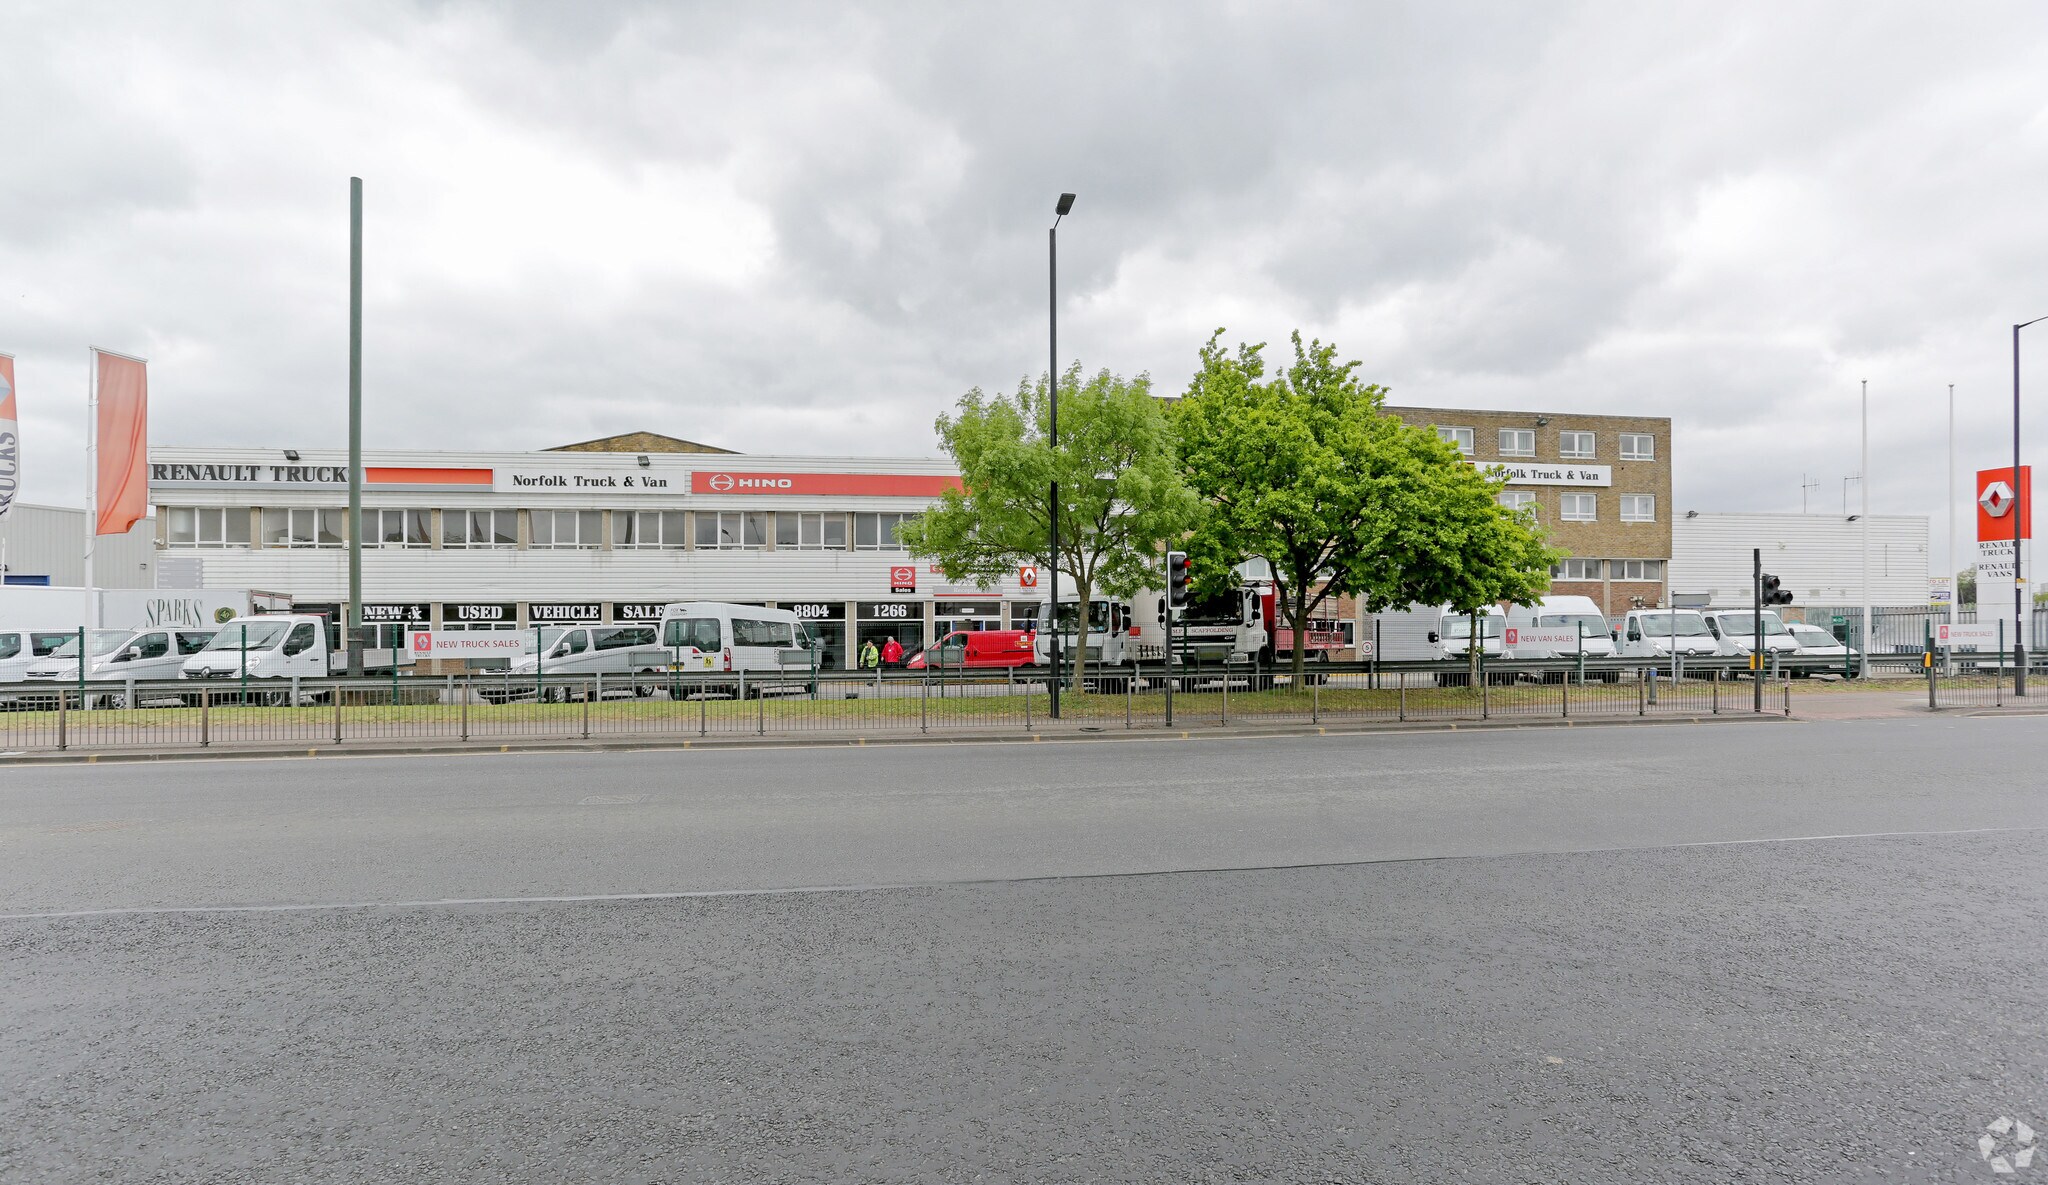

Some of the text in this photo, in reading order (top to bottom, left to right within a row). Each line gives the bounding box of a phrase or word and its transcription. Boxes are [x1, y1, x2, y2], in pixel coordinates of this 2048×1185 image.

[152, 464, 349, 482] RENAULT TRUCK
[1531, 469, 1562, 479] Truck
[1566, 470, 1575, 480] &
[1580, 471, 1599, 480] Van
[512, 474, 668, 488] Norfolk Truck & Van
[738, 478, 792, 488] HINO
[146, 598, 203, 628] SPARKS
[363, 606, 422, 620] NEW &
[458, 605, 503, 619] USED
[532, 606, 599, 619] VEHICLE
[622, 605, 664, 619] SALE
[793, 604, 830, 617] 8804
[873, 604, 907, 618] 1266
[436, 639, 520, 648] NEW TRUCK SALES
[1554, 634, 1574, 642] SALES
